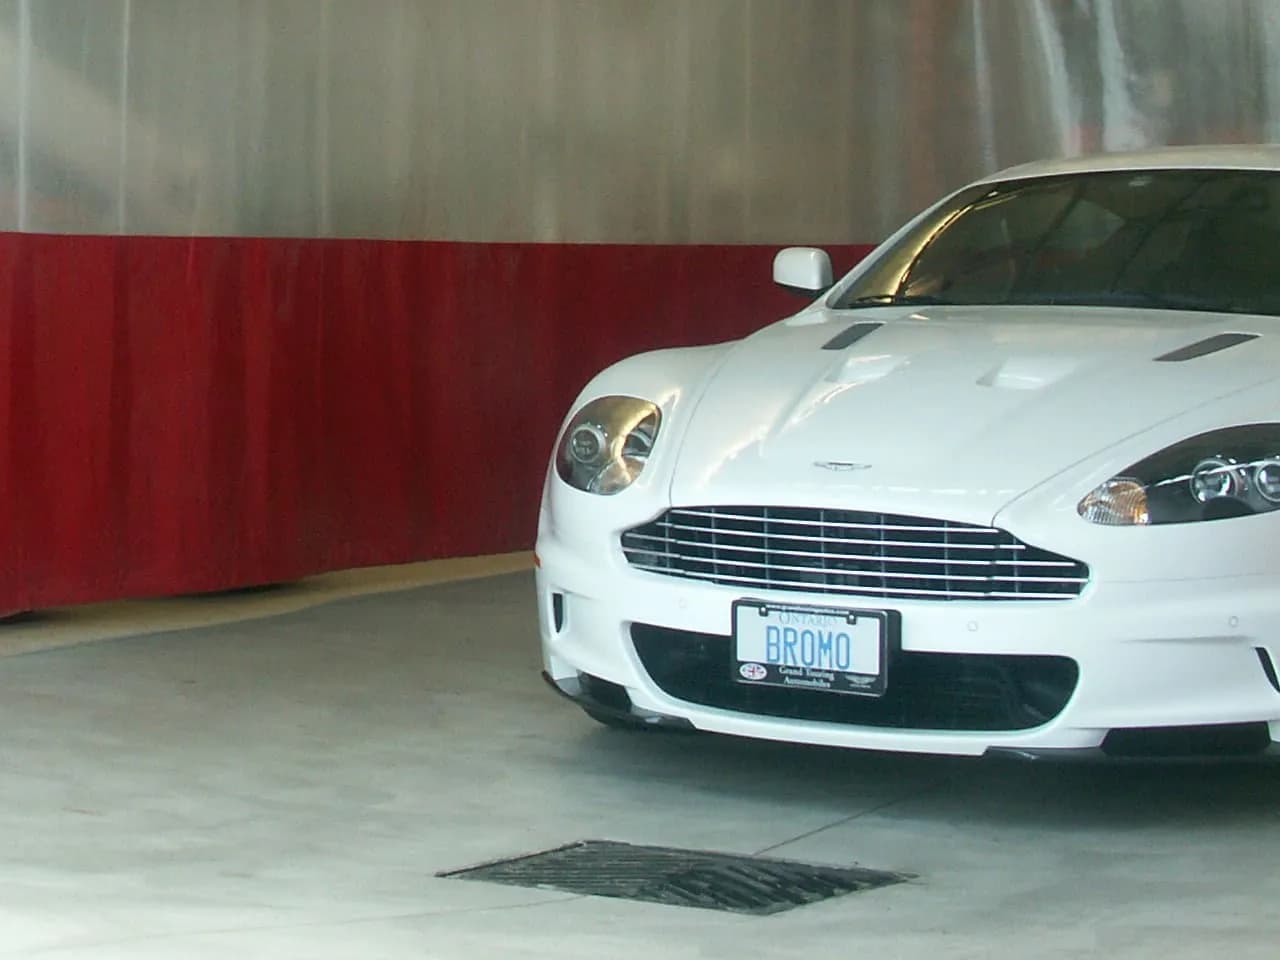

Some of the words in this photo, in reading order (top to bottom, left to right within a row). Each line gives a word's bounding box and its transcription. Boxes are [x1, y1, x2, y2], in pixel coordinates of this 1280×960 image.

[766, 626, 850, 670] BROMO
[779, 666, 803, 676] Grand
[805, 667, 835, 681] Touring
[783, 675, 831, 688] Automobiles
